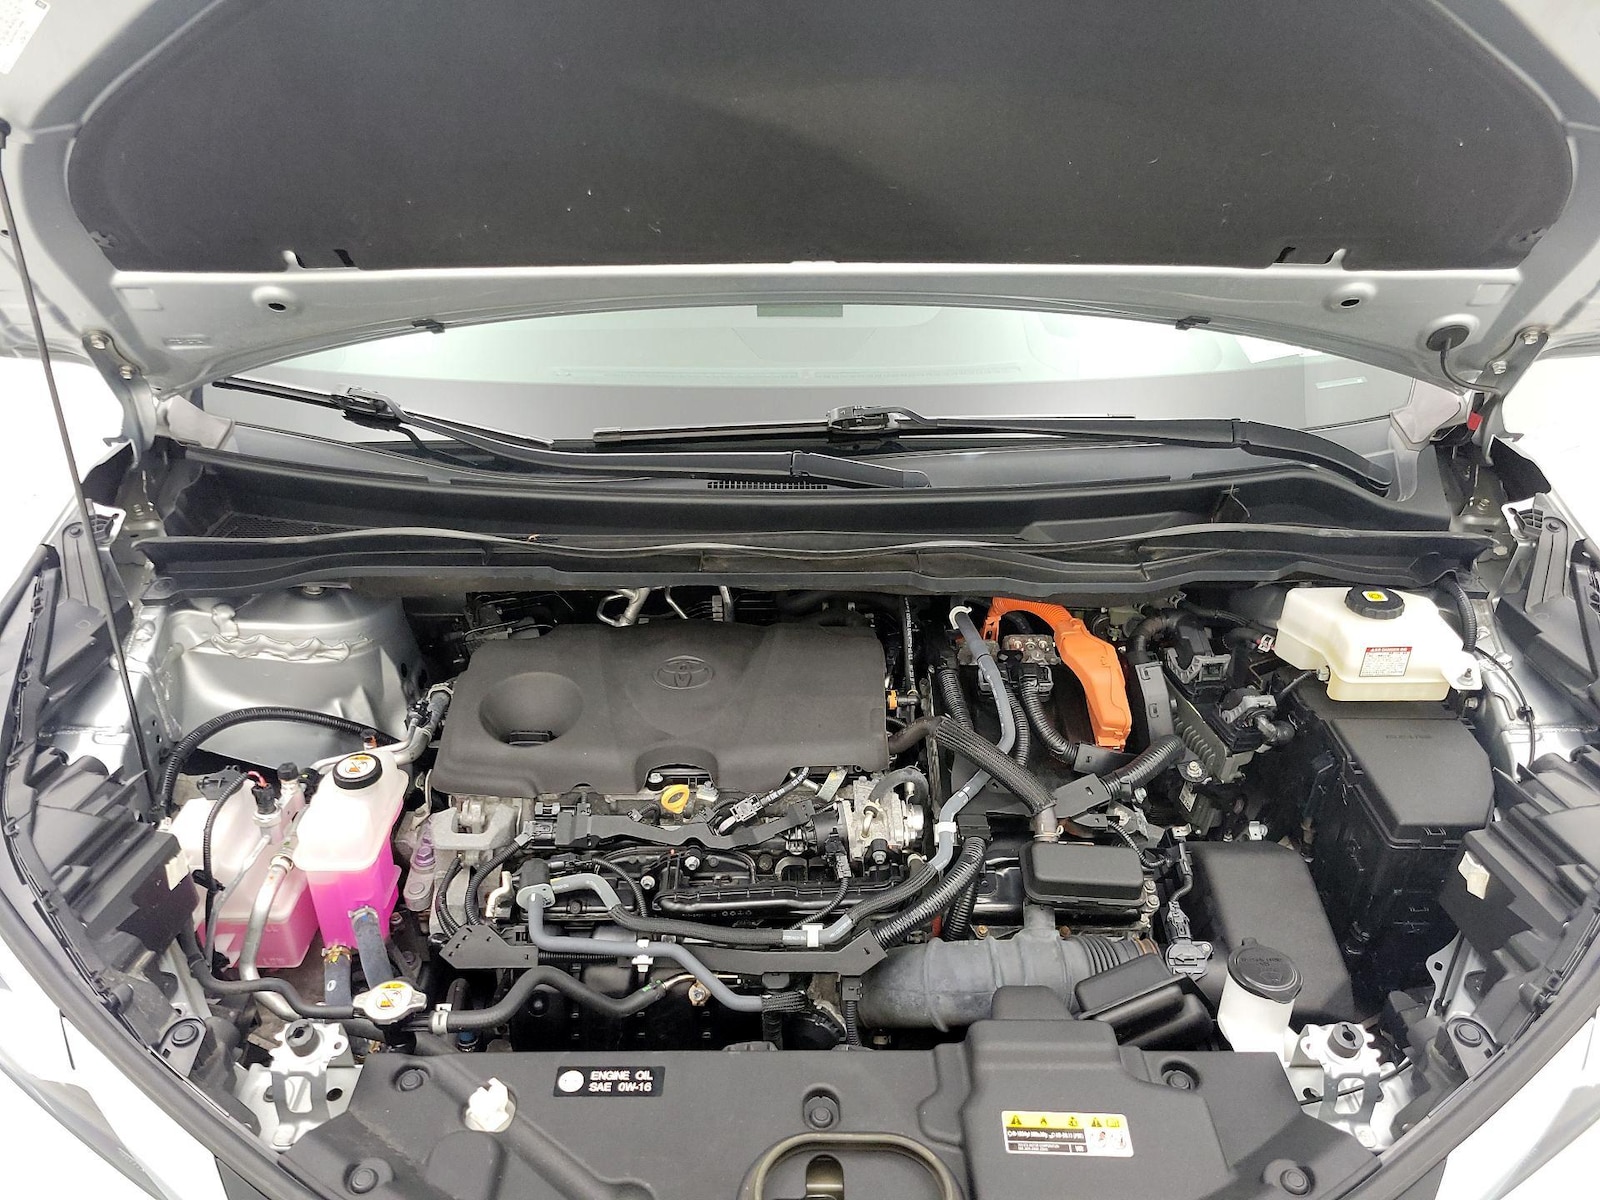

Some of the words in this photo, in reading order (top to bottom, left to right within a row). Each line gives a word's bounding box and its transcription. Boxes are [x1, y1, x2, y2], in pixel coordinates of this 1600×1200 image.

[590, 1070, 631, 1081] ENGINE
[634, 1070, 653, 1081] OIL
[588, 1081, 612, 1092] SAE
[617, 1081, 652, 1092] 0W-16
